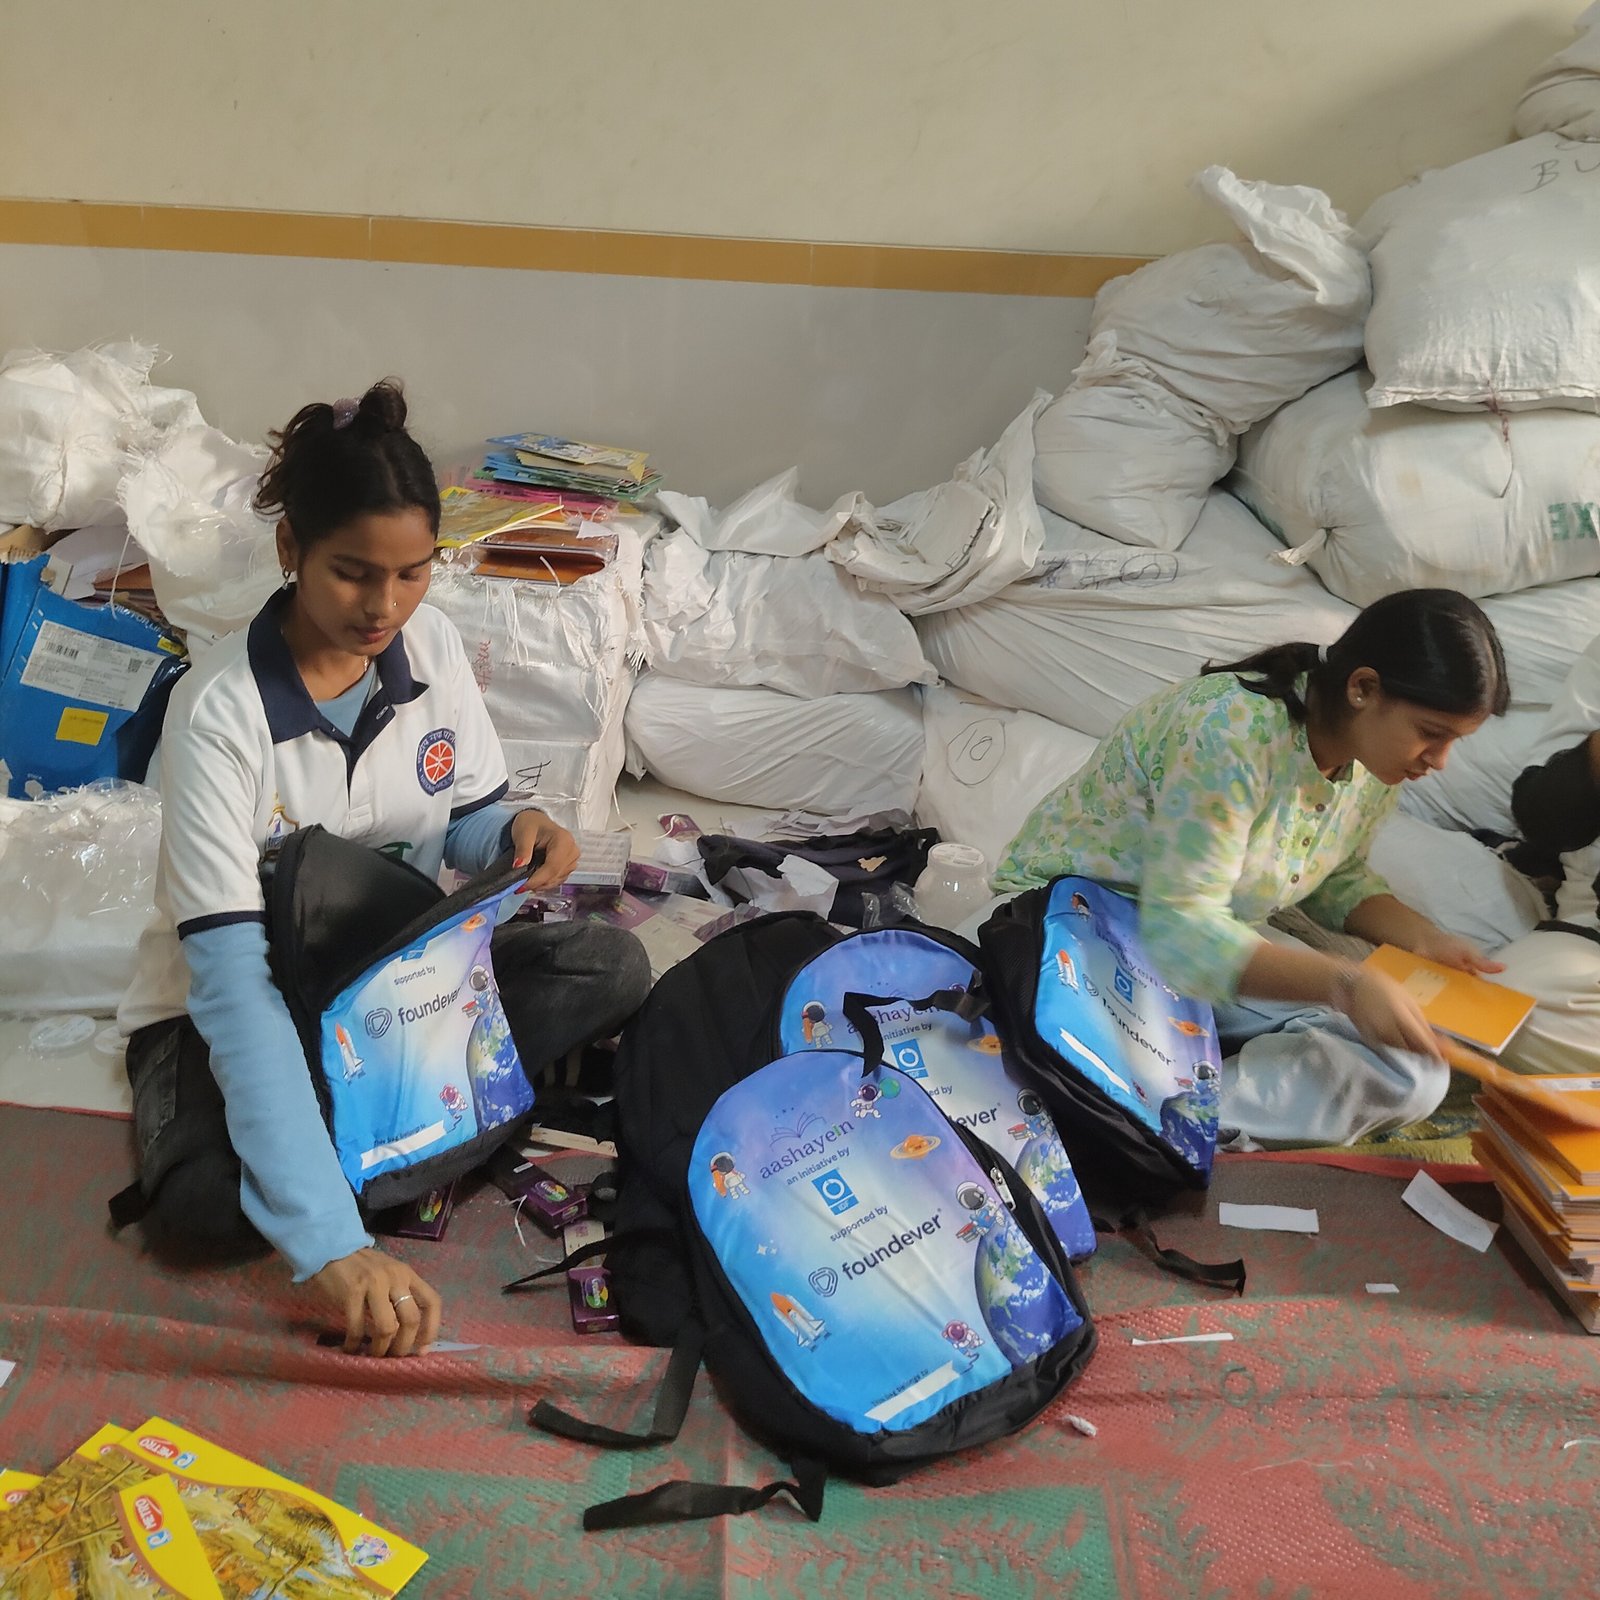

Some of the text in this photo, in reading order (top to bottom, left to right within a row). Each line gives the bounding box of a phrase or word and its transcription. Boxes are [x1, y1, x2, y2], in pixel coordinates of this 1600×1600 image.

[426, 965, 436, 975] by
[884, 1022, 932, 1041] nitiative by
[941, 1084, 953, 1095] by
[786, 1147, 850, 1186] an initiative by
[830, 1205, 888, 1242] supported by
[842, 1214, 942, 1281] foundever
[139, 1437, 174, 1459] METRO
[135, 1497, 157, 1530] METRO
